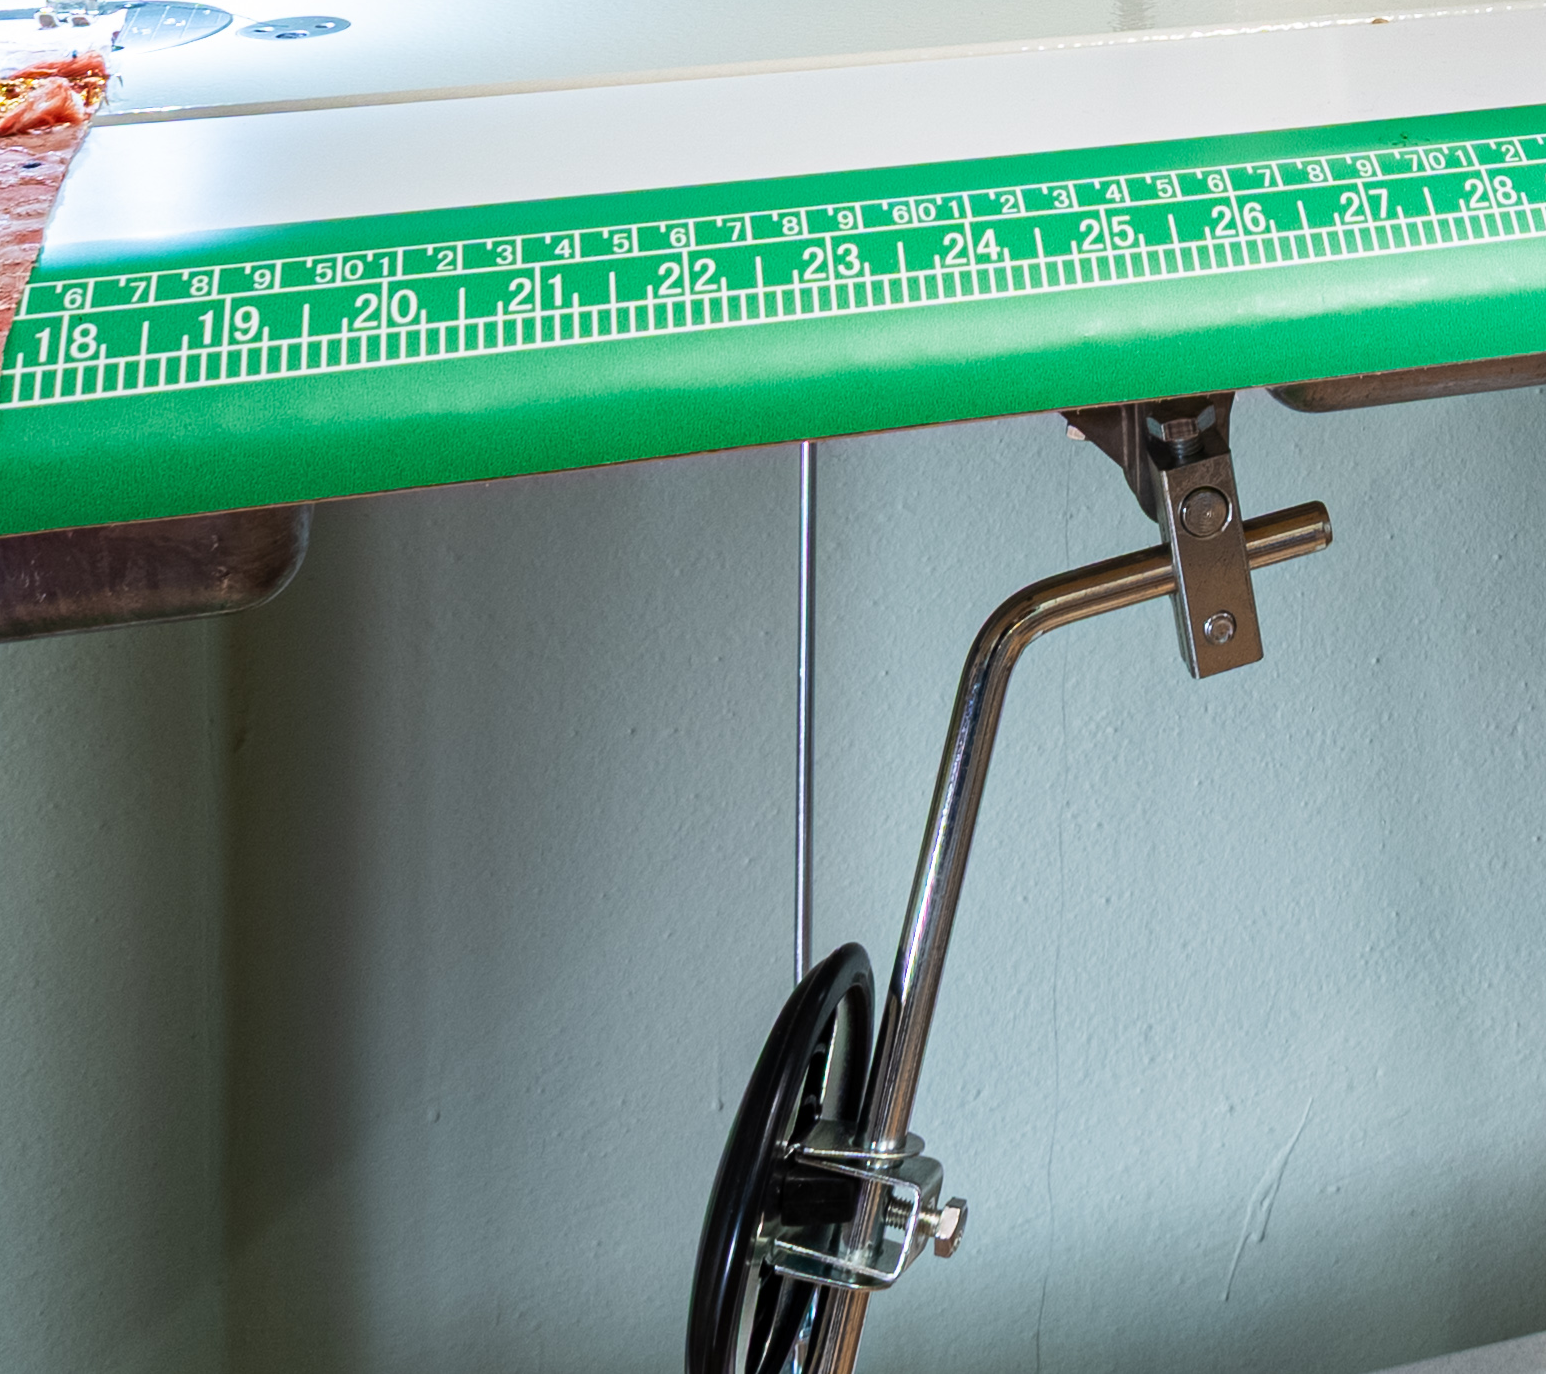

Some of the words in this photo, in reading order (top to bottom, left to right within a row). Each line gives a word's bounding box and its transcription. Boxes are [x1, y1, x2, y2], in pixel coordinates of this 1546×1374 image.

[35, 323, 98, 363] 18
[198, 305, 260, 345] 19
[352, 288, 418, 329] 20
[507, 273, 562, 313] 21
[657, 257, 718, 297] 22
[801, 243, 861, 281] 23
[943, 228, 1001, 266] 24
[1078, 215, 1135, 252] 25
[1210, 201, 1267, 238] 26
[1339, 188, 1388, 225] 27
[1464, 175, 1518, 211] 28
[63, 287, 84, 311] 6
[129, 281, 148, 303] 7
[189, 274, 210, 297] 8
[253, 268, 273, 291] 9
[436, 250, 454, 272] 2
[495, 244, 514, 266] 3
[554, 238, 572, 258] 4
[612, 233, 629, 254] 5
[669, 227, 687, 248] 6
[725, 221, 743, 241] 7
[781, 215, 799, 236] 8
[837, 210, 854, 231] 9
[1000, 194, 1018, 214] 2
[1053, 188, 1071, 209] 3
[1105, 183, 1122, 203] 4
[1156, 178, 1173, 198] 5
[1206, 173, 1224, 193] 6
[1256, 168, 1272, 188] 7
[1307, 163, 1325, 183] 8
[1355, 158, 1374, 178] 9
[1501, 143, 1519, 163] 2
